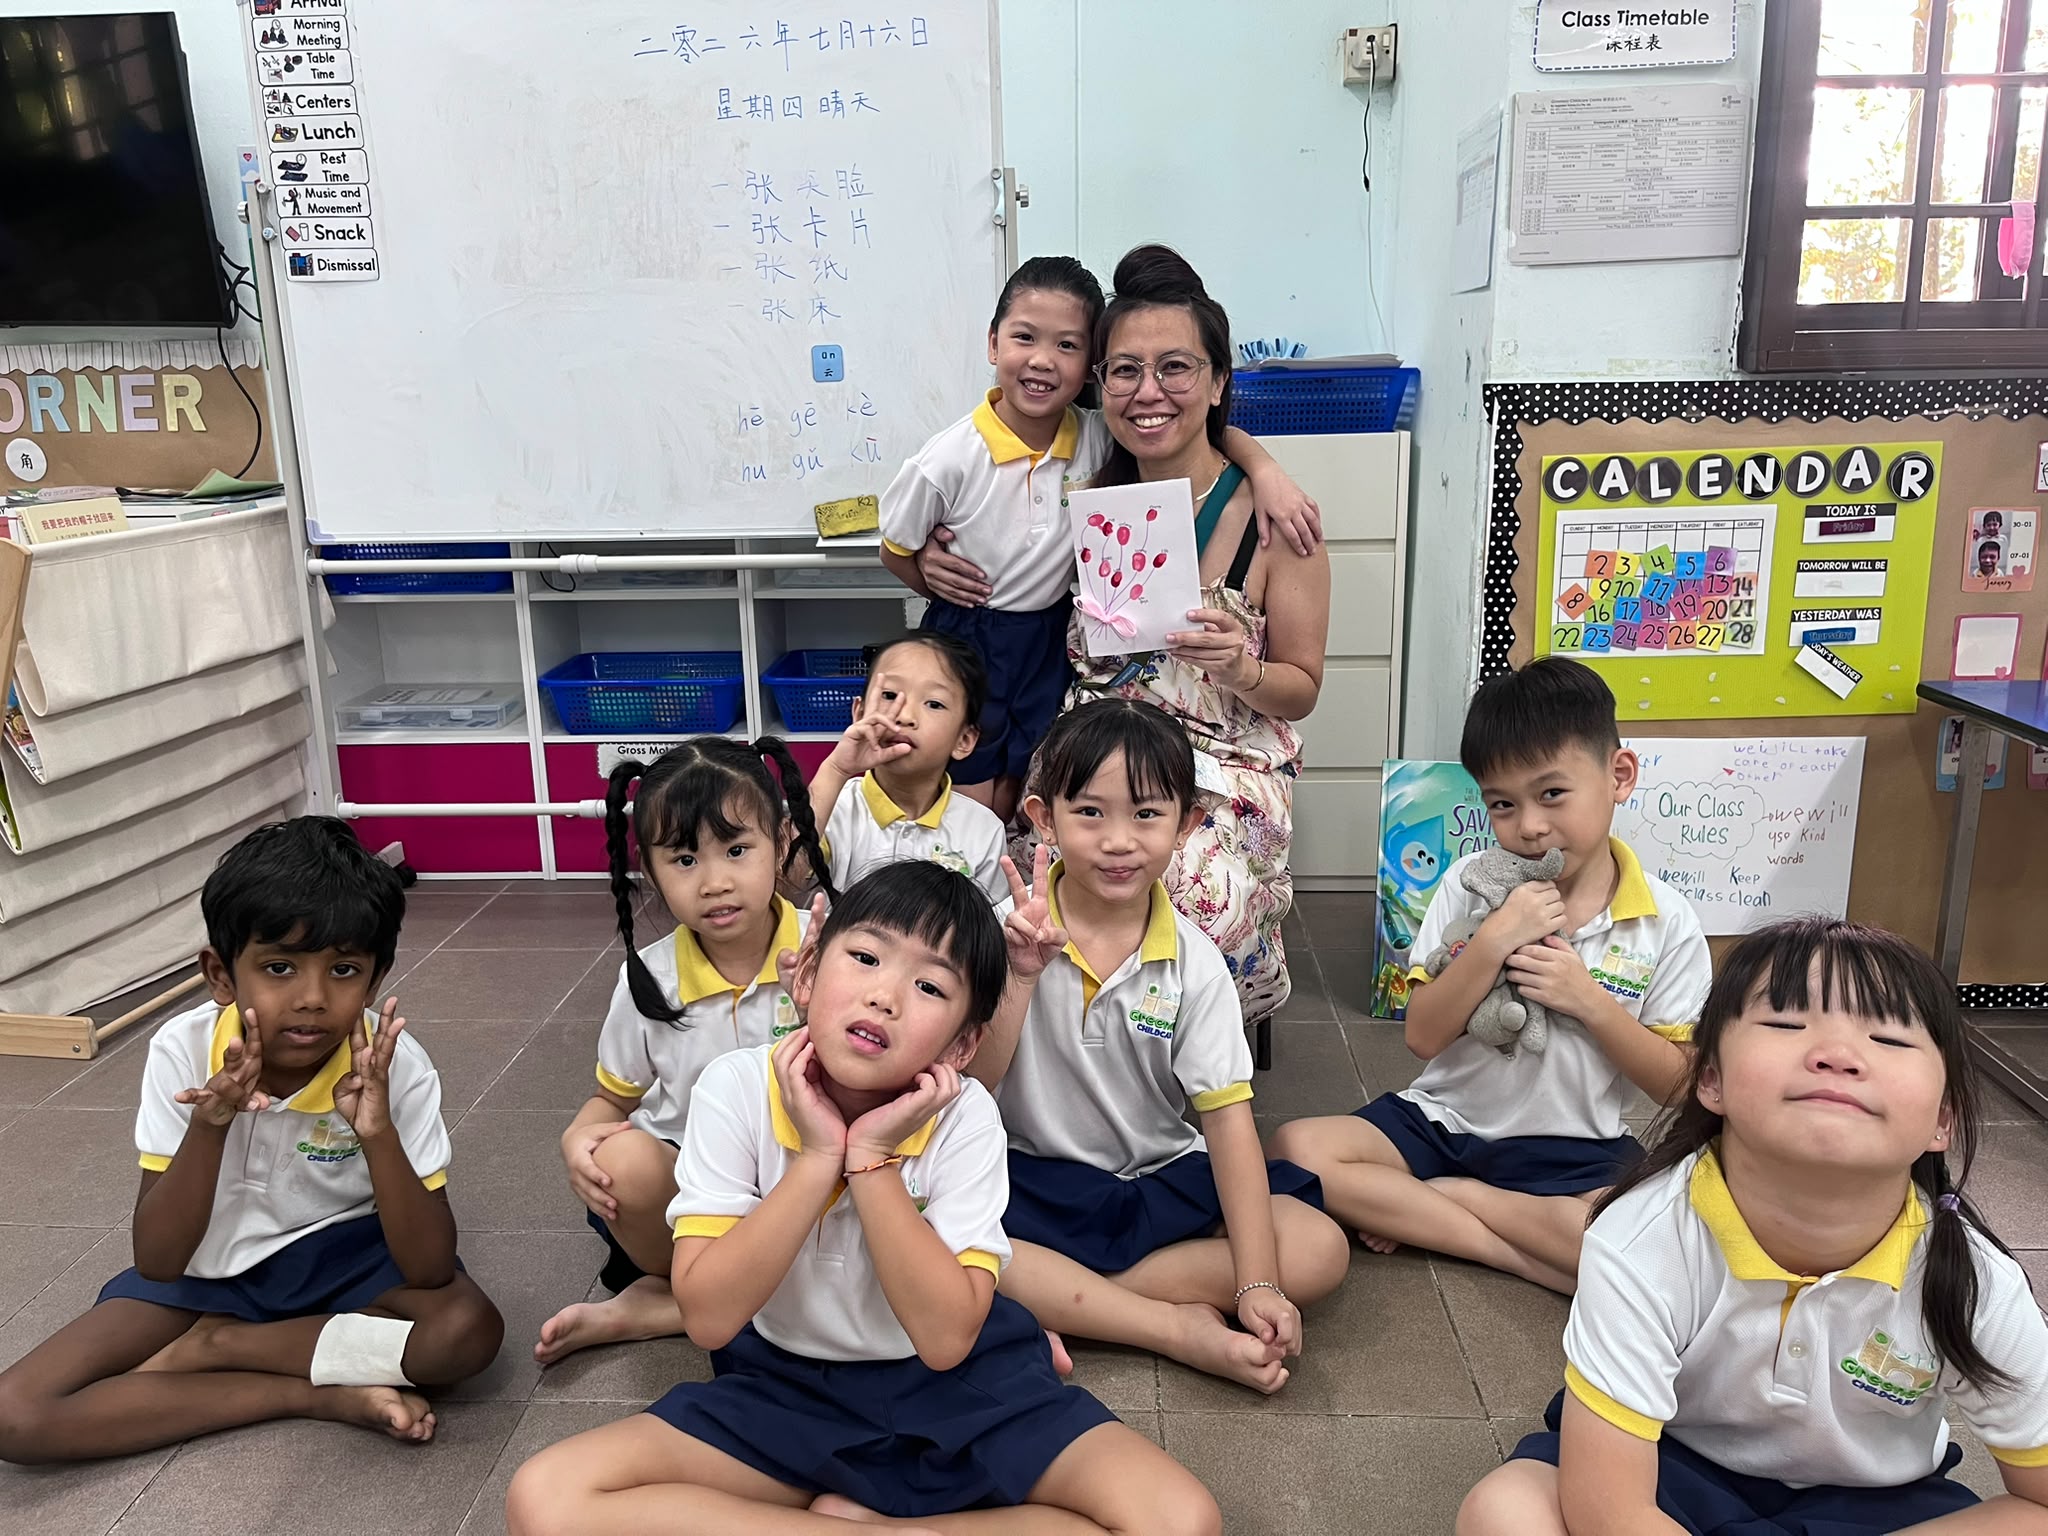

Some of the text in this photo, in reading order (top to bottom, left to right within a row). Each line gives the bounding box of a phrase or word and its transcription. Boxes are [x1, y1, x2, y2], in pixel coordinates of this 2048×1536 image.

[293, 18, 340, 32] Morning
[1561, 9, 1709, 27] Class Timetable
[296, 34, 341, 49] Meeting
[1606, 33, 1663, 52] 课程表
[306, 52, 335, 64] Table
[310, 68, 335, 80] Time
[295, 94, 351, 109] Centers
[301, 121, 356, 140] Lunch
[320, 151, 346, 164] Rest
[322, 170, 350, 182] Time
[305, 186, 361, 198] Music and
[307, 202, 362, 214] Movement
[314, 223, 367, 241] Snack
[317, 258, 376, 271] Dismissal
[20, 453, 33, 470] 角
[1552, 448, 1930, 498] CALENDAR
[1825, 504, 1876, 517] TODAY IS
[1832, 520, 1865, 532] Friday
[1593, 552, 1726, 576] 2 3 4 5 6
[1799, 560, 1886, 571] TOMORROW WILL BE
[1566, 592, 1584, 609] 8
[1599, 578, 1611, 599] 9
[1614, 580, 1635, 598] 10
[1649, 578, 1670, 601] 11
[1706, 573, 1731, 594] 13
[1732, 576, 1753, 597] 14
[1588, 604, 1610, 623] 16
[1621, 601, 1640, 621] 17
[1674, 594, 1696, 618] 19
[1703, 599, 1728, 621] 20
[1730, 599, 1753, 617] 21
[1793, 608, 1880, 622] YESTERDAY WAS
[1553, 621, 1754, 648] 22 23 24 25 26 27 28
[1808, 642, 1862, 682] ODAY'S WEATHER
[617, 745, 646, 755] Gross
[1658, 791, 1692, 818] Our
[1697, 793, 1745, 818] Class
